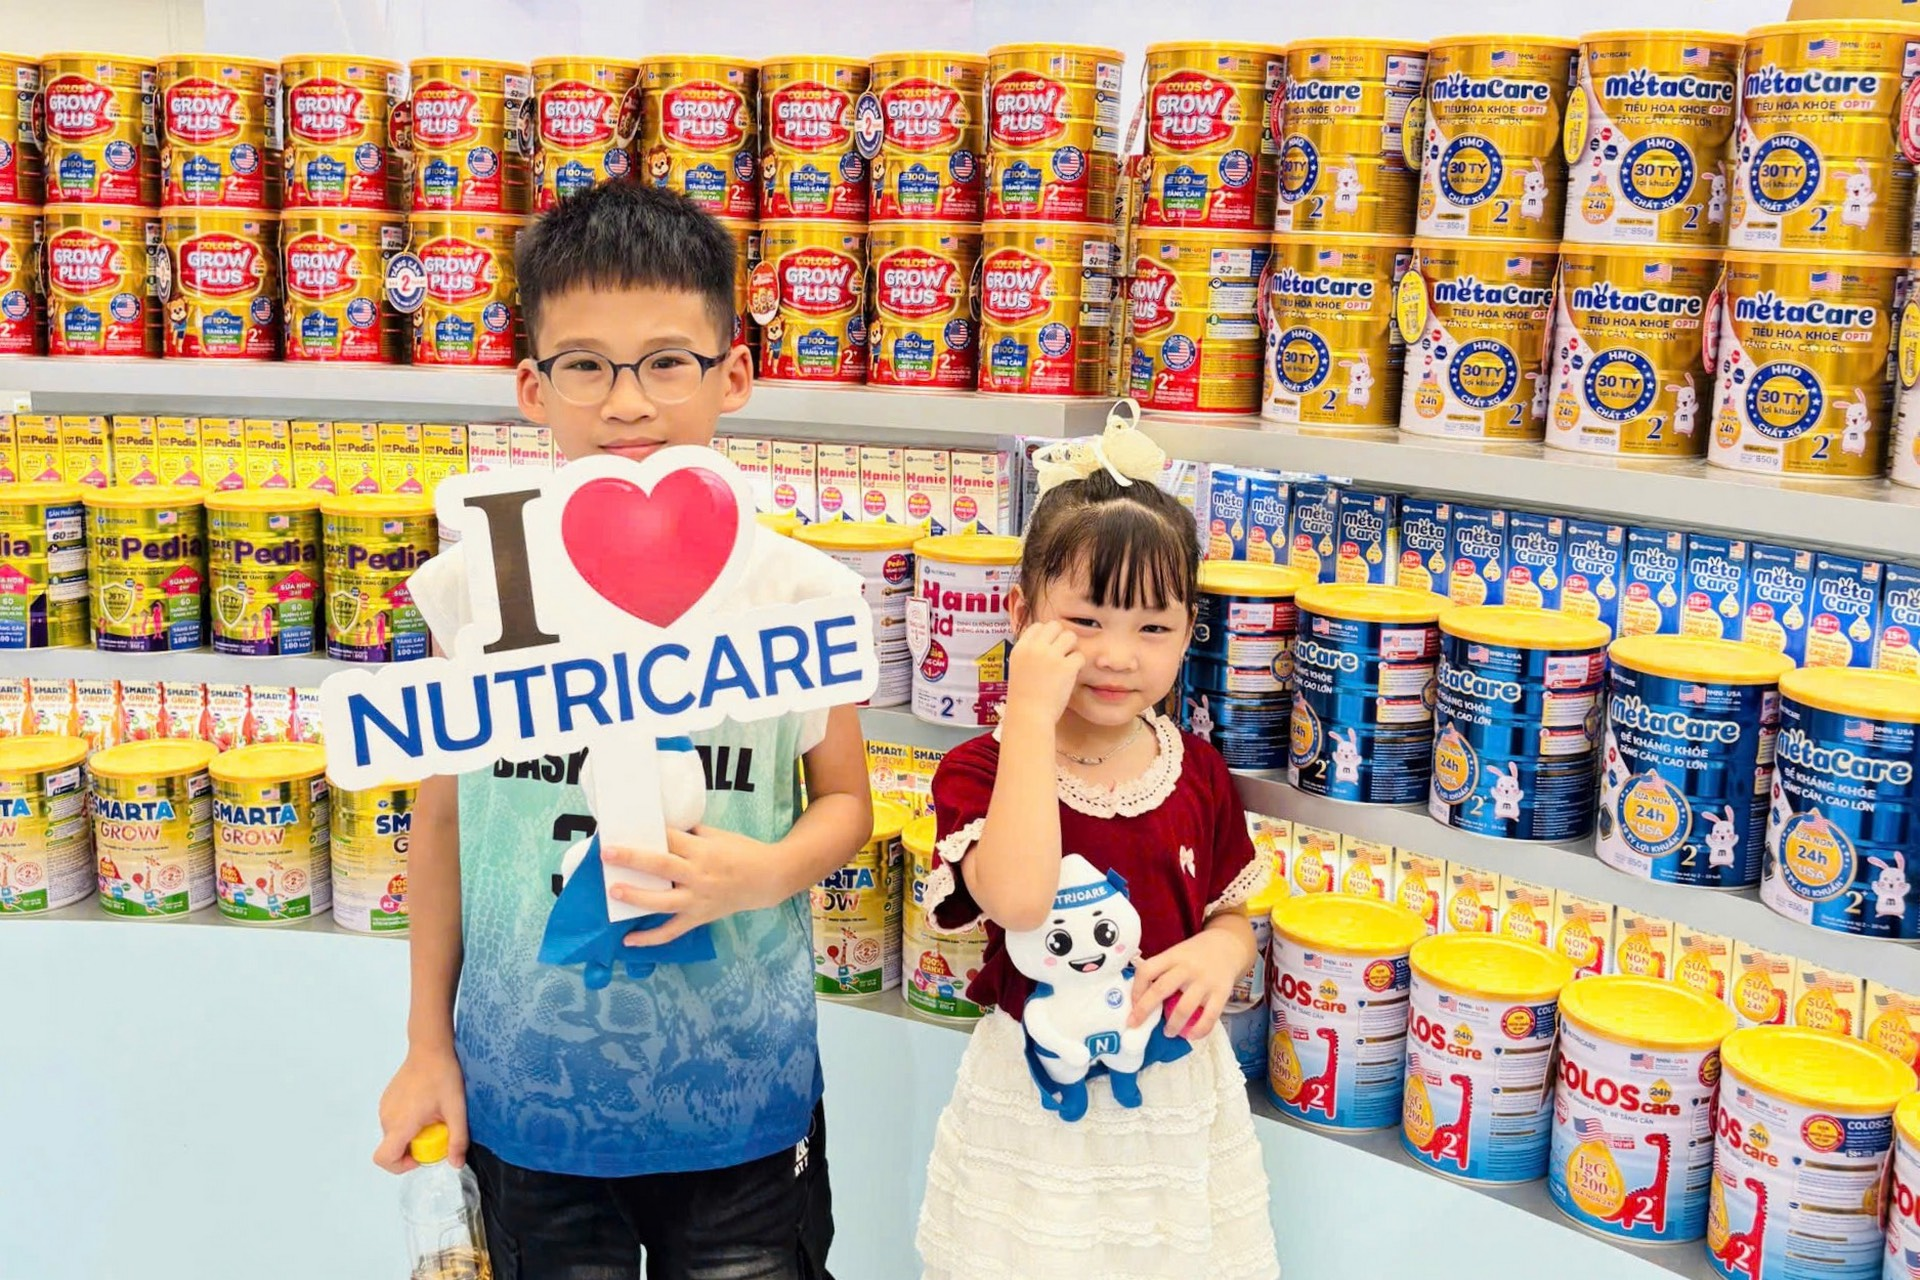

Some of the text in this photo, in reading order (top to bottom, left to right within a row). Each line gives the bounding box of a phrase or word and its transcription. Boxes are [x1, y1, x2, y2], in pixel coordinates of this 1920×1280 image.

[295, 95, 354, 114] GROW
[416, 99, 467, 117] GROW
[545, 98, 604, 118] GROW
[671, 100, 735, 119] GROW
[887, 97, 951, 118] GROW
[996, 91, 1055, 113] GROW
[1156, 90, 1225, 114] GROW
[1710, 105, 1729, 114] OPTI
[778, 101, 840, 120] GROW
[1522, 106, 1543, 114] OPTI
[301, 115, 347, 130] PLUS
[420, 119, 458, 133] PLUS
[551, 119, 595, 134] PLUS
[679, 120, 727, 136] PLUS
[785, 120, 832, 136] PLUS
[894, 120, 941, 135] PLUS
[1000, 114, 1045, 131] PLUS
[1162, 116, 1213, 135] PLUS
[1288, 139, 1304, 148] HMO
[1459, 138, 1485, 148] HMO
[1647, 138, 1675, 149] HMO
[1771, 137, 1799, 149] HMO
[1450, 162, 1466, 173] 30
[1635, 164, 1655, 176] 30
[1588, 199, 1606, 210] 24h
[291, 252, 347, 270] GROW
[426, 256, 483, 273] GROW
[796, 257, 830, 265] COLOS
[296, 271, 337, 287] PLUS
[786, 264, 850, 285] GROW
[885, 268, 946, 288] GROW
[986, 269, 1041, 289] GROW
[431, 275, 474, 290] PLUS
[793, 286, 841, 302] PLUS
[891, 289, 937, 305] PLUS
[990, 291, 1031, 309] PLUS
[1291, 330, 1313, 340] HMO
[1845, 332, 1869, 341] OPTI
[1473, 343, 1500, 351] HMO
[1609, 352, 1636, 362] HMO
[1771, 365, 1800, 377] HMO
[1760, 391, 1778, 405] 30
[1720, 422, 1735, 433] 24h
[216, 439, 241, 449] Pedia
[259, 439, 285, 450] Pedia
[304, 443, 331, 452] Pedia
[349, 443, 375, 453] Pedia
[392, 445, 420, 454] Pedia
[435, 446, 463, 457] Pedia
[470, 445, 507, 458] Hanie
[511, 447, 550, 460] Hanie
[774, 465, 812, 476] Hanie
[820, 467, 857, 479] Hanie
[862, 469, 901, 482] Hanie
[907, 472, 946, 484] Hanie
[953, 475, 994, 488] Hanie
[1215, 505, 1242, 520] Care
[1255, 513, 1284, 527] Care
[1301, 519, 1332, 535] Care
[1347, 525, 1380, 542] Care
[52, 530, 66, 540] 60
[121, 534, 200, 560] Pedia
[1408, 535, 1444, 551] Care
[1461, 542, 1500, 558] Care
[234, 538, 317, 564] Pedia
[348, 544, 431, 571] Pedia
[1515, 550, 1557, 567] Care
[463, 488, 560, 655] I
[1572, 559, 1615, 576] Care
[1633, 567, 1676, 582] Care
[1694, 576, 1738, 592] Care
[1757, 584, 1804, 604] Care
[1822, 598, 1870, 616] Care
[34, 687, 68, 695] SMARTA
[124, 686, 157, 695] SMARTA
[167, 689, 199, 697] SMARTA
[211, 690, 243, 698] SMARTA
[347, 615, 863, 767] NUTRICARE
[870, 745, 909, 757] SMARTA
[1633, 736, 1671, 753] KHÁNG
[1674, 746, 1709, 758] KHỎE
[1440, 755, 1458, 772] 24h
[1663, 758, 1684, 767] CAO
[1796, 772, 1876, 799] KHÁNG KHỎE
[92, 798, 176, 822] SMARTA
[213, 803, 298, 826] SMARTA
[1636, 805, 1665, 822] 24h
[101, 822, 161, 840] GROW
[221, 826, 285, 846] GROW
[1637, 822, 1663, 836] USA
[1798, 846, 1828, 865] 24h
[1056, 887, 1107, 905] TRICARE
[1564, 938, 1588, 951] NON
[1626, 953, 1649, 965] NON
[1683, 970, 1708, 983] NON
[1319, 986, 1338, 994] 24h
[1743, 989, 1769, 1002] NON
[1313, 998, 1347, 1014] care
[1805, 1009, 1833, 1023] NON
[1453, 1028, 1473, 1039] 24h
[1879, 1031, 1907, 1045] NON
[1093, 1037, 1109, 1052] N
[1447, 1044, 1482, 1061] care
[1650, 1086, 1671, 1098] 24h
[1641, 1101, 1680, 1116] care
[1749, 1128, 1769, 1142] 24h
[1742, 1143, 1779, 1167] care
[1579, 1154, 1606, 1178] IgG
